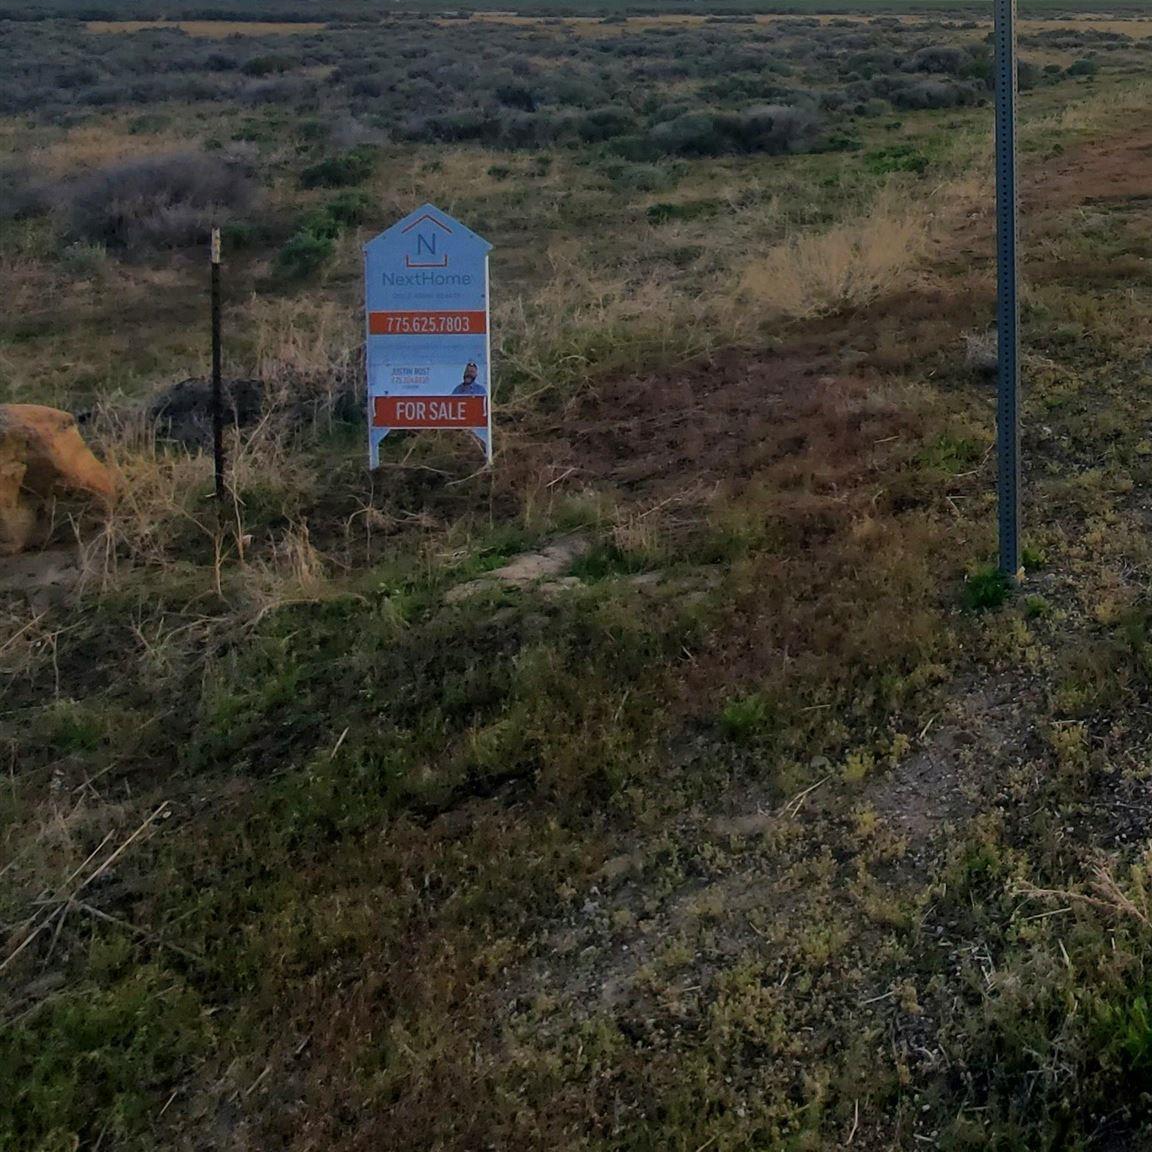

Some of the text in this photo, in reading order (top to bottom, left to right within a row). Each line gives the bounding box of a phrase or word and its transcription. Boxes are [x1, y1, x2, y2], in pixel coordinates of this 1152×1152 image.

[417, 233, 436, 255] N
[382, 271, 472, 287] NextHome
[386, 316, 469, 332] 775.625.7803
[396, 401, 467, 421] FOR SALE
